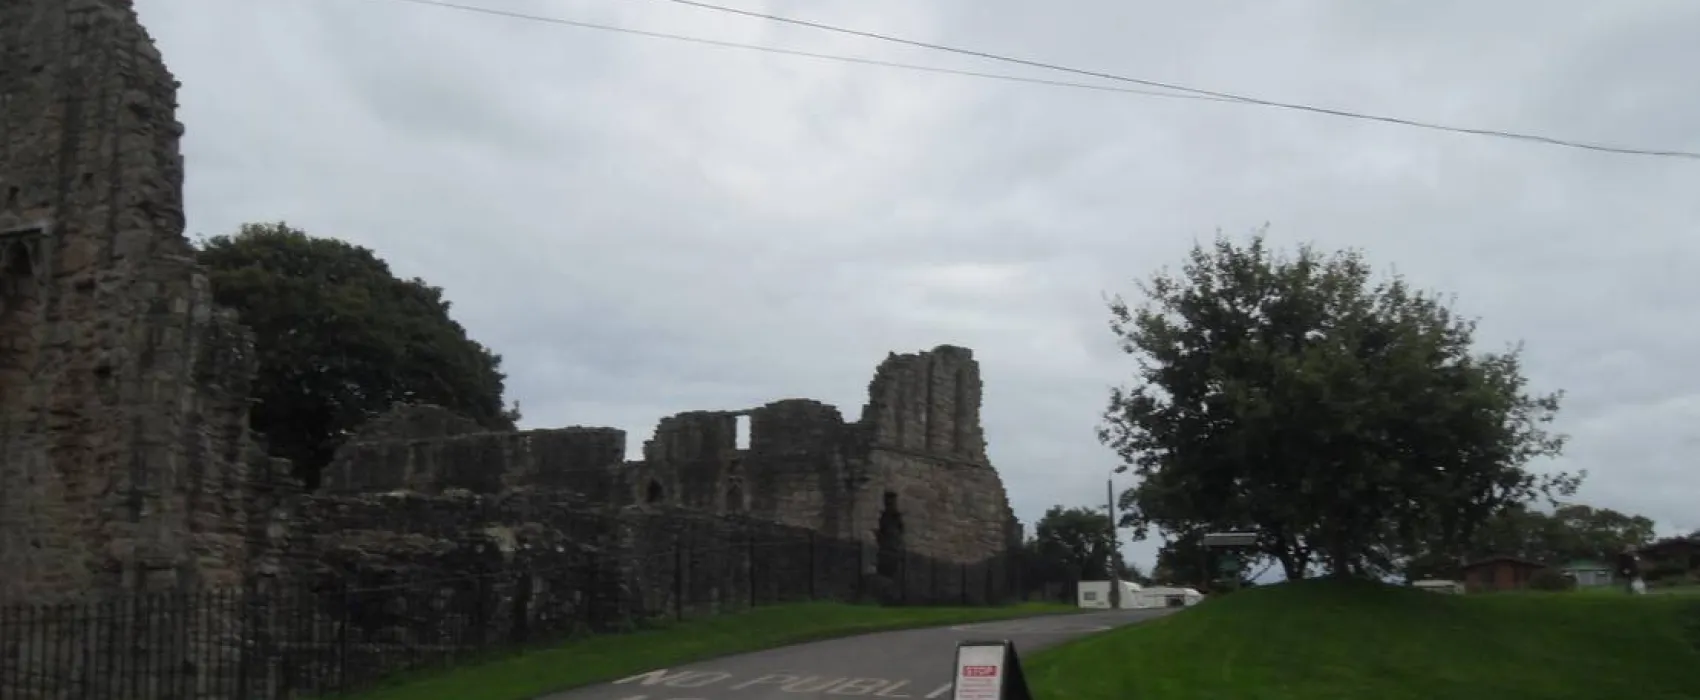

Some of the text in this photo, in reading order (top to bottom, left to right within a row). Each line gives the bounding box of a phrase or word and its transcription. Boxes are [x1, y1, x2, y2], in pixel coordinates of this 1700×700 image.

[965, 666, 996, 677] STOP
[612, 668, 732, 687] NO
[730, 672, 953, 699] PUBLI
